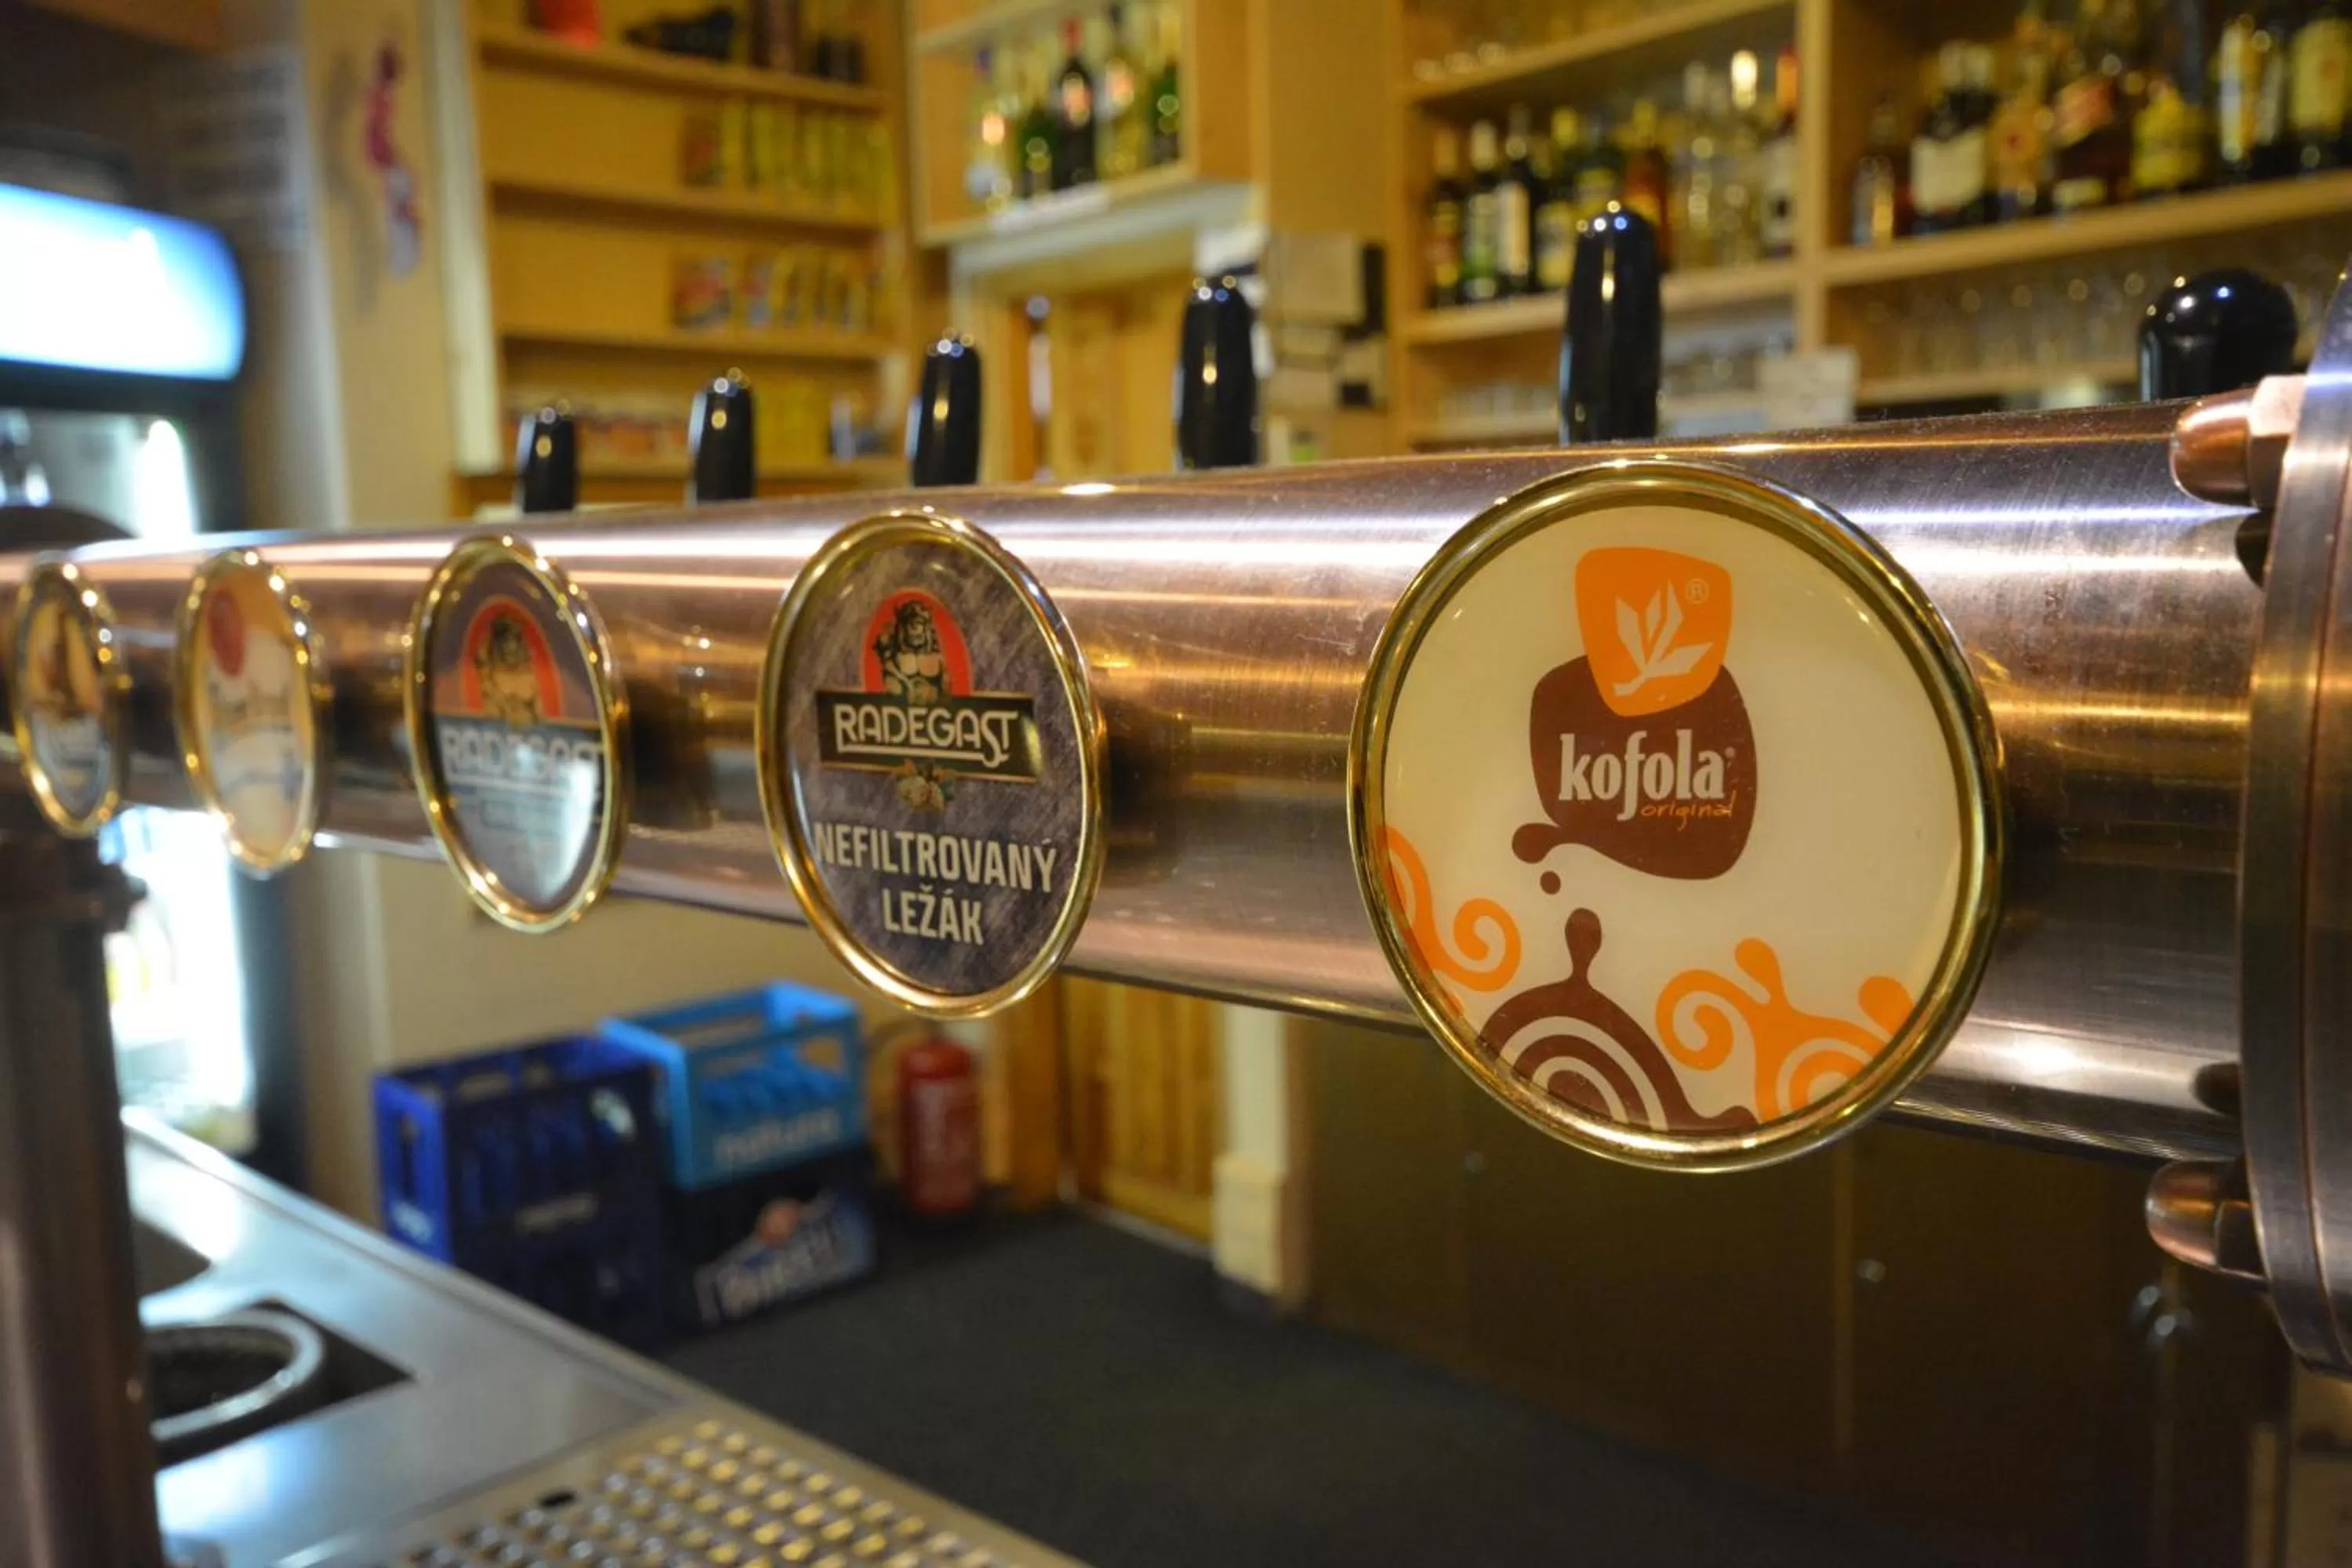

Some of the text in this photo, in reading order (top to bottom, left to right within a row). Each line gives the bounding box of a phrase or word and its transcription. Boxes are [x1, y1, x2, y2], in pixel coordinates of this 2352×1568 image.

[834, 704, 1018, 768] RADEGAST
[1559, 729, 1725, 822] kofola
[1641, 789, 1737, 832] original
[814, 822, 1057, 892] NEFILTROVANÝ
[882, 884, 984, 946] LEŽÁK
